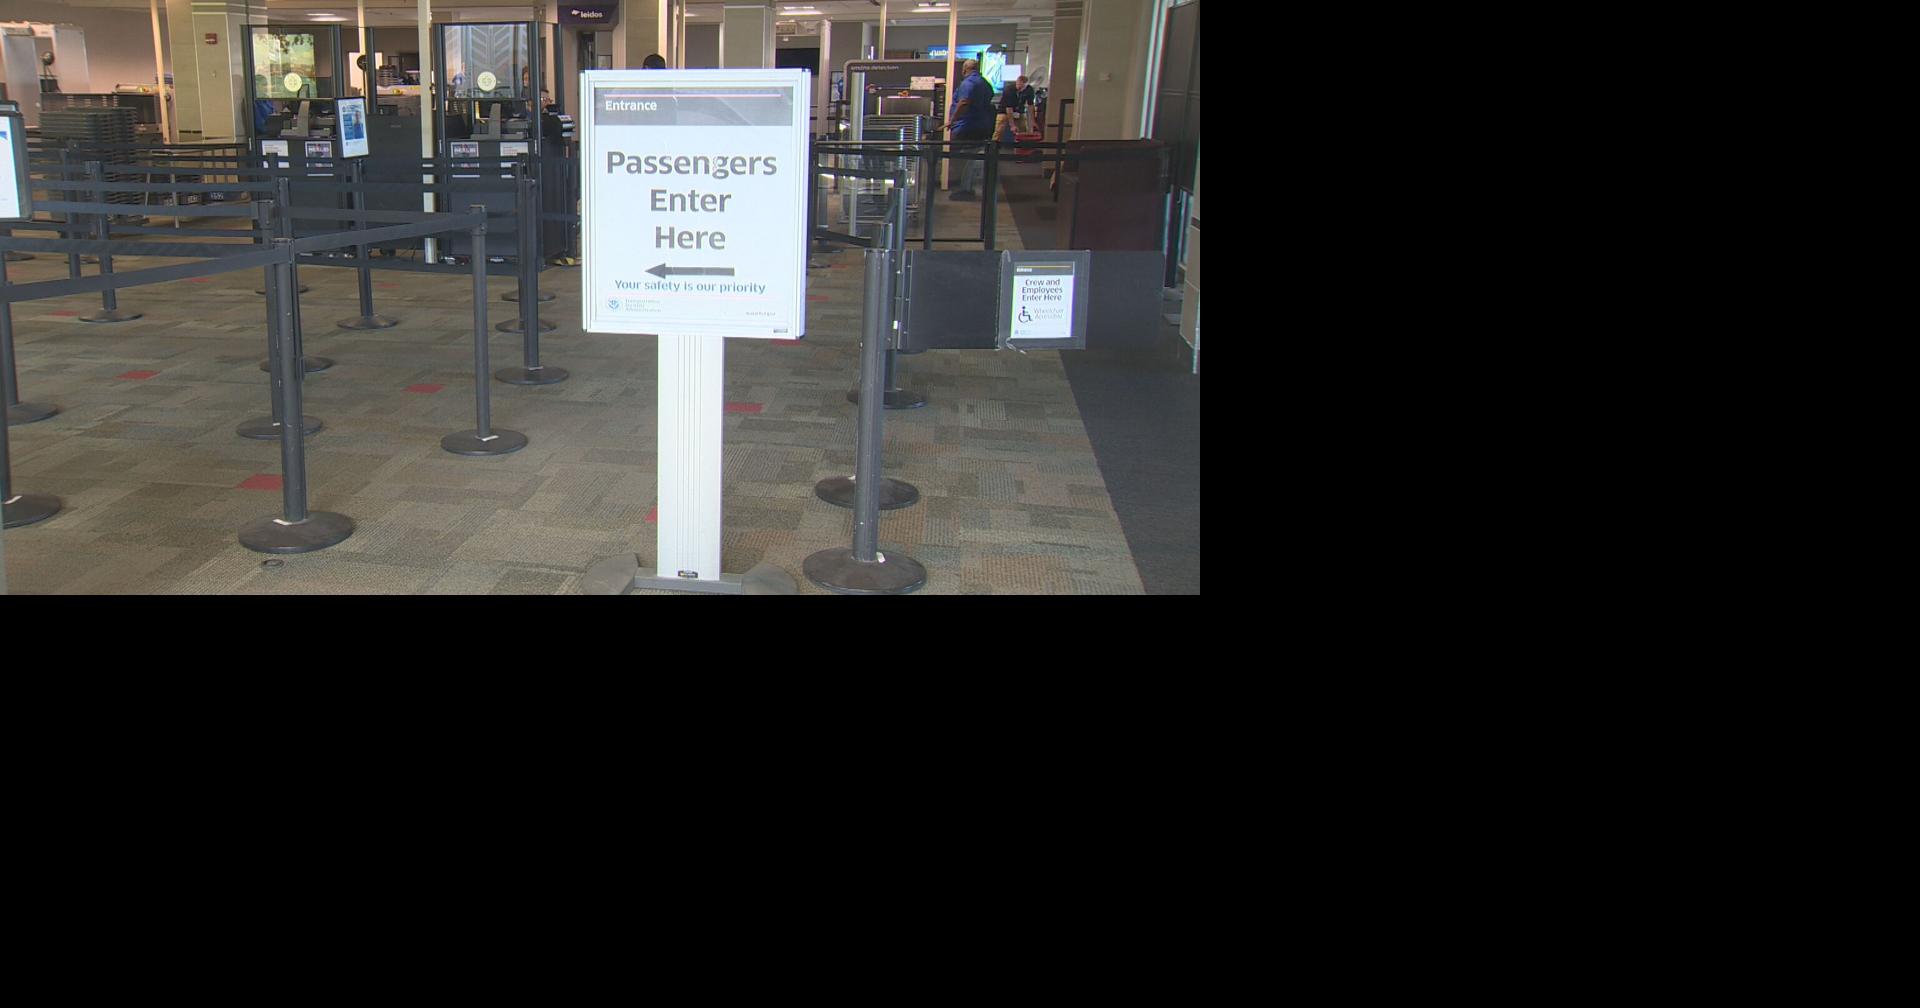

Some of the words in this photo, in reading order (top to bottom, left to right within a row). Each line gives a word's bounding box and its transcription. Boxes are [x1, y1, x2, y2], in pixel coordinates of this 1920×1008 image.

[605, 100, 657, 112] Entrance
[606, 151, 778, 180] Passengers
[650, 188, 732, 213] Enter
[655, 226, 726, 250] Here
[614, 279, 642, 290] Your
[644, 280, 681, 293] safety
[683, 281, 694, 291] is
[696, 283, 717, 292] our
[719, 282, 766, 295] priority
[1021, 286, 1063, 295] Employees
